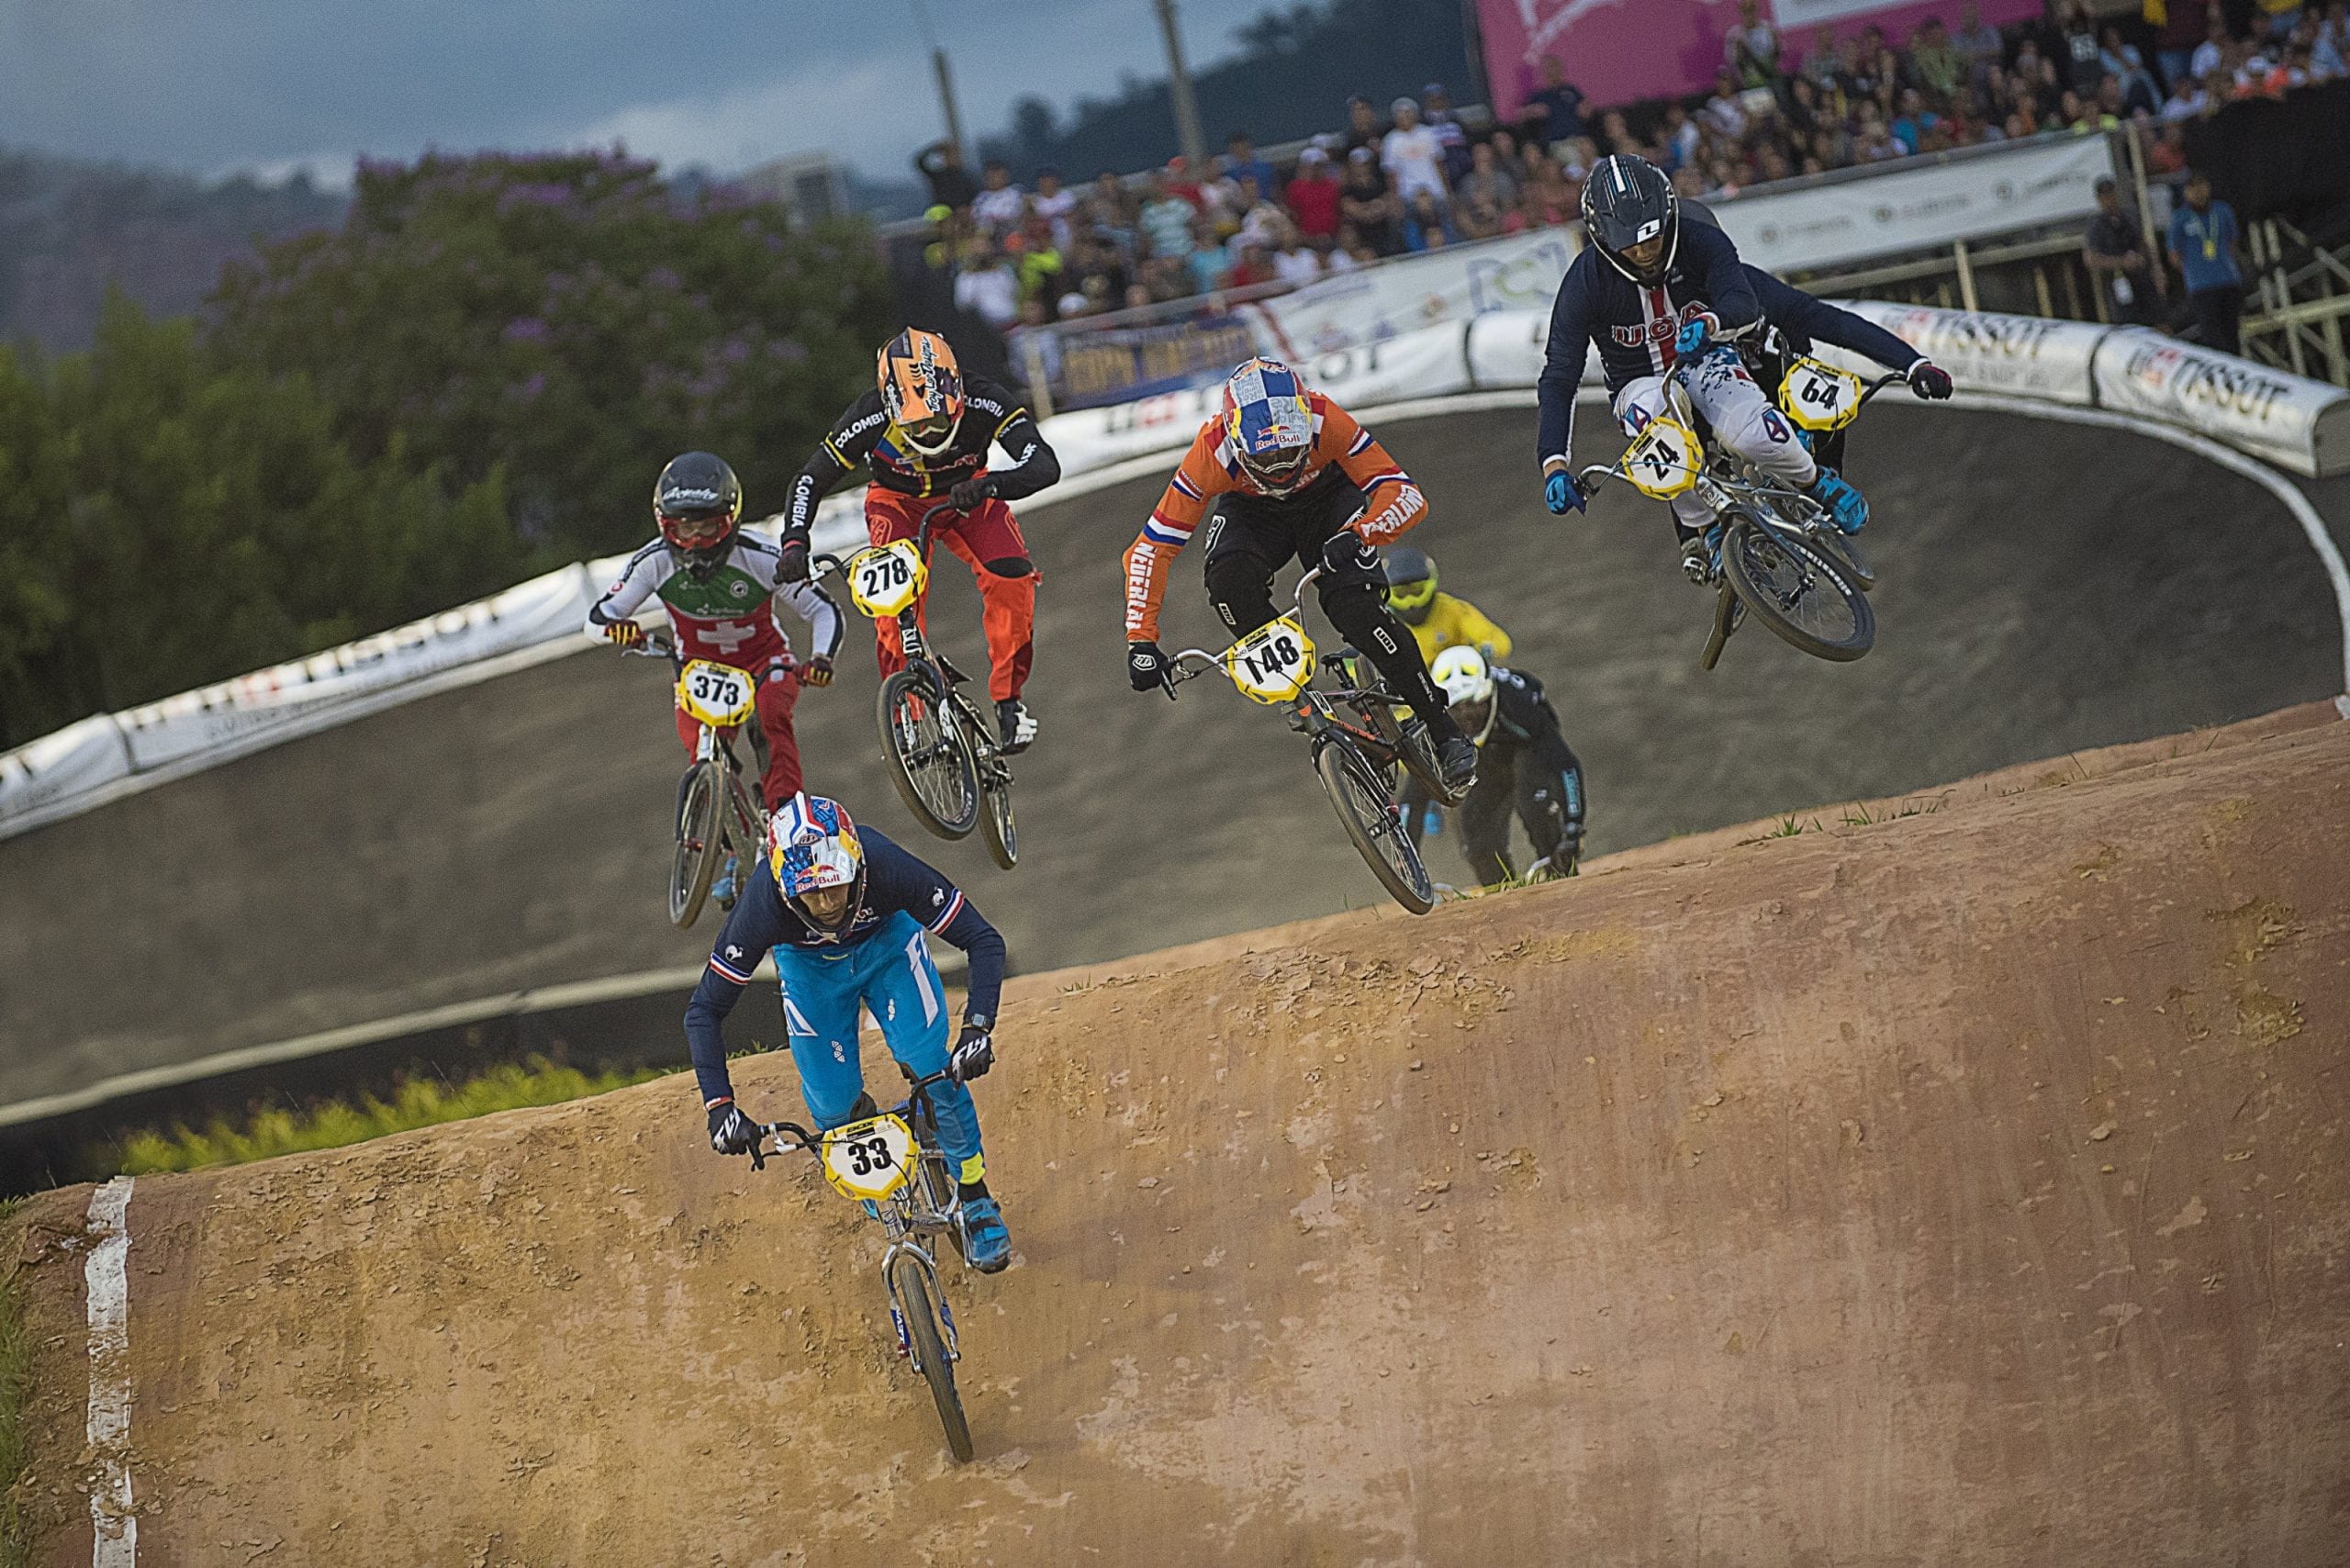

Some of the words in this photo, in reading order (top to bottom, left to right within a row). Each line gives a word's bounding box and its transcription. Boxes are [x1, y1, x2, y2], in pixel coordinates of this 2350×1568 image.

[1612, 300, 1709, 347] USA
[1801, 377, 1840, 410] 64
[2173, 356, 2288, 421] TISSOT
[834, 410, 886, 449] COLOMBI
[1256, 434, 1278, 451] Red
[1279, 433, 1301, 444] Bull
[1643, 439, 1680, 481] 24
[863, 557, 908, 598] 278
[1245, 636, 1300, 685] 148
[694, 675, 739, 706] 373
[795, 878, 817, 893] Red
[818, 873, 840, 884] Bull
[952, 1036, 988, 1076] FLY
[714, 1107, 741, 1148] FLY
[846, 1121, 875, 1133] BOX
[848, 1137, 891, 1175] 33
